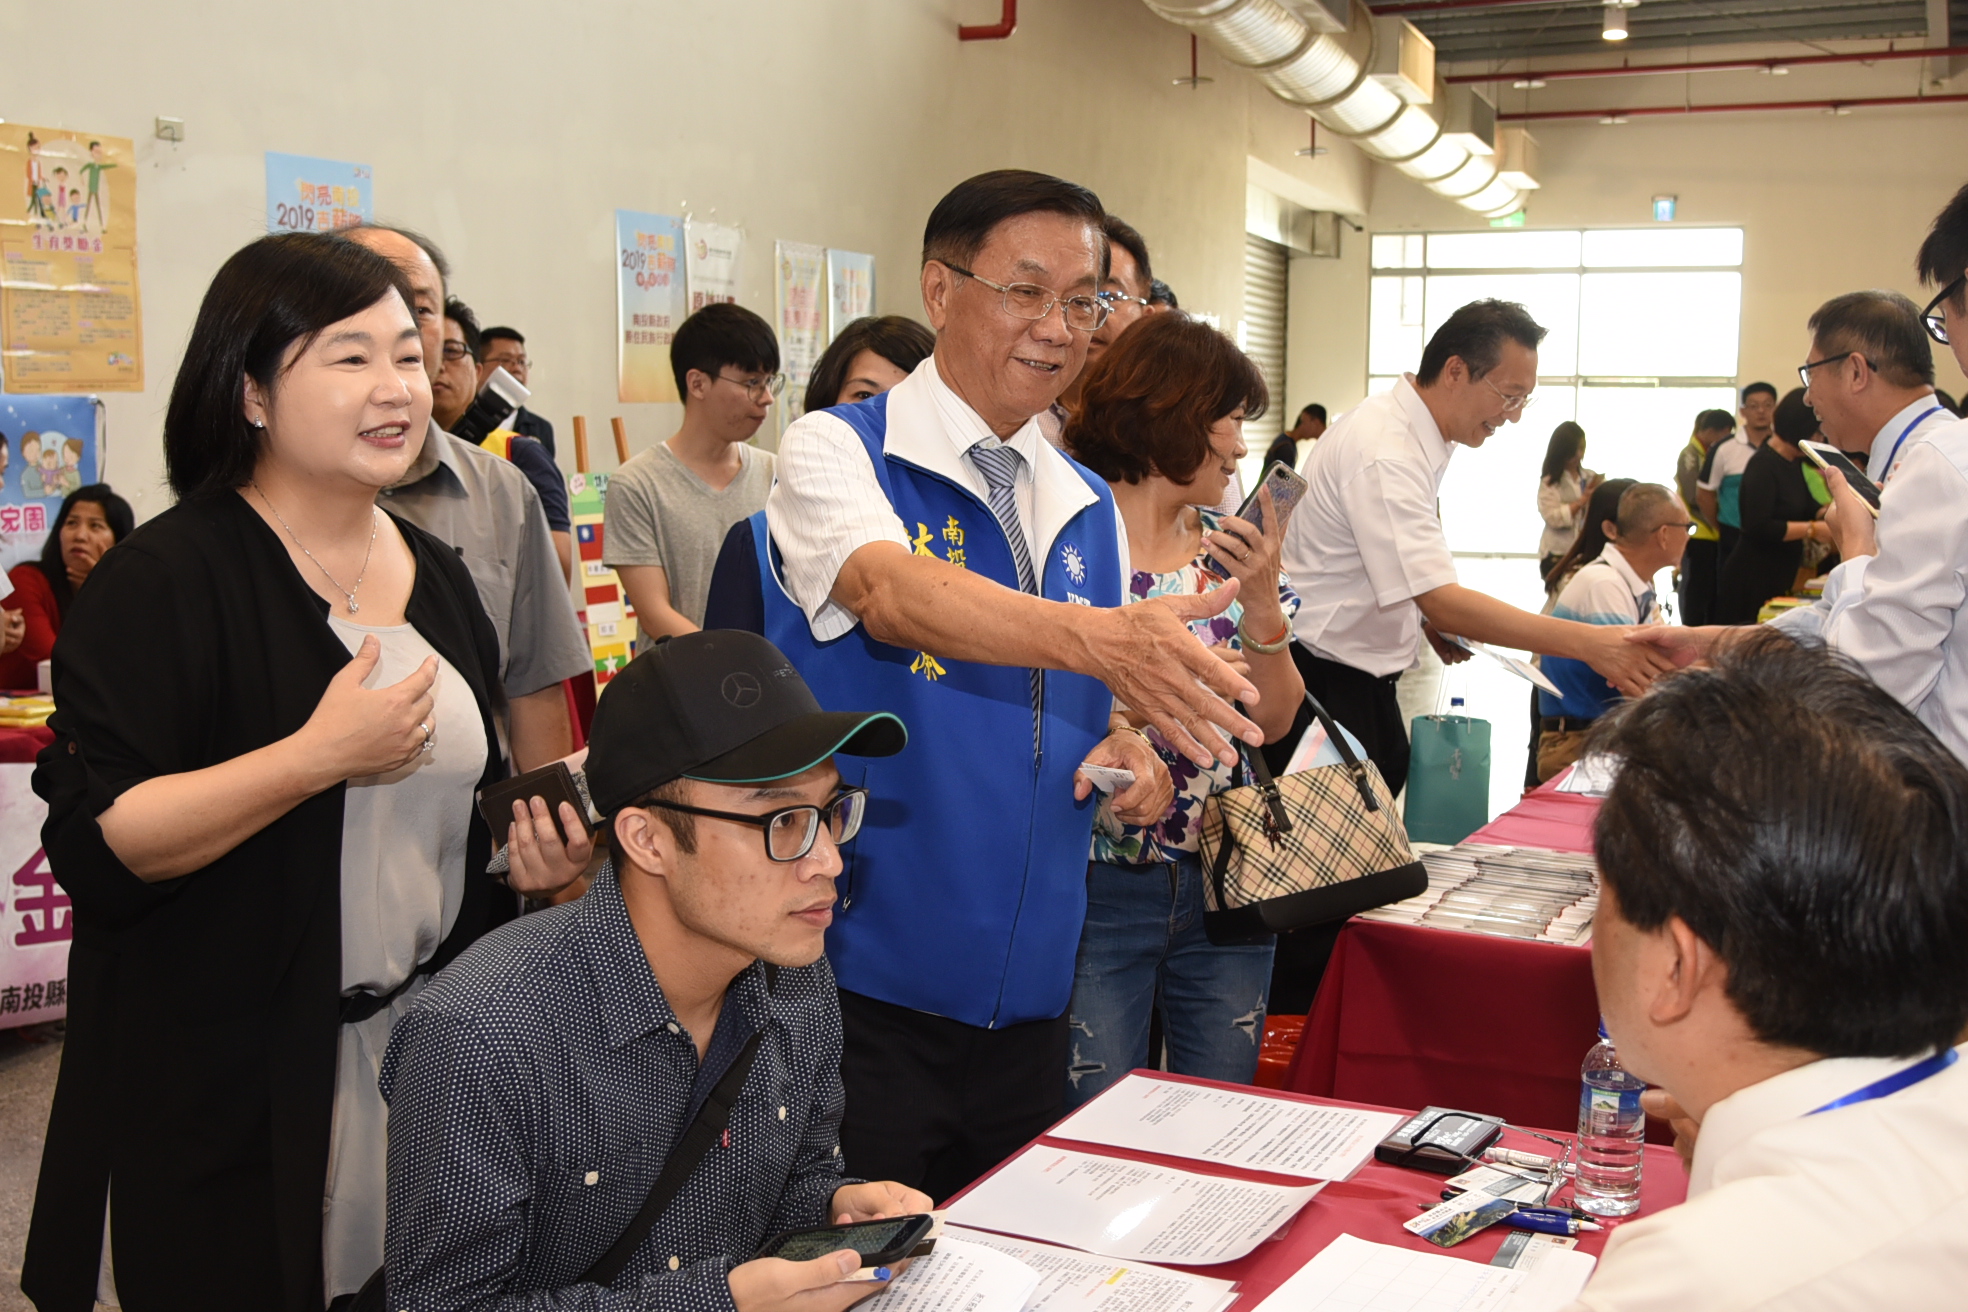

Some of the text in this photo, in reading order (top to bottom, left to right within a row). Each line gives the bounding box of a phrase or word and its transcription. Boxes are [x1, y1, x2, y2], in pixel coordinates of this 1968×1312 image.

[277, 202, 314, 229] 2019
[622, 249, 647, 272] 2019
[0, 977, 67, 1017] 南投縣
